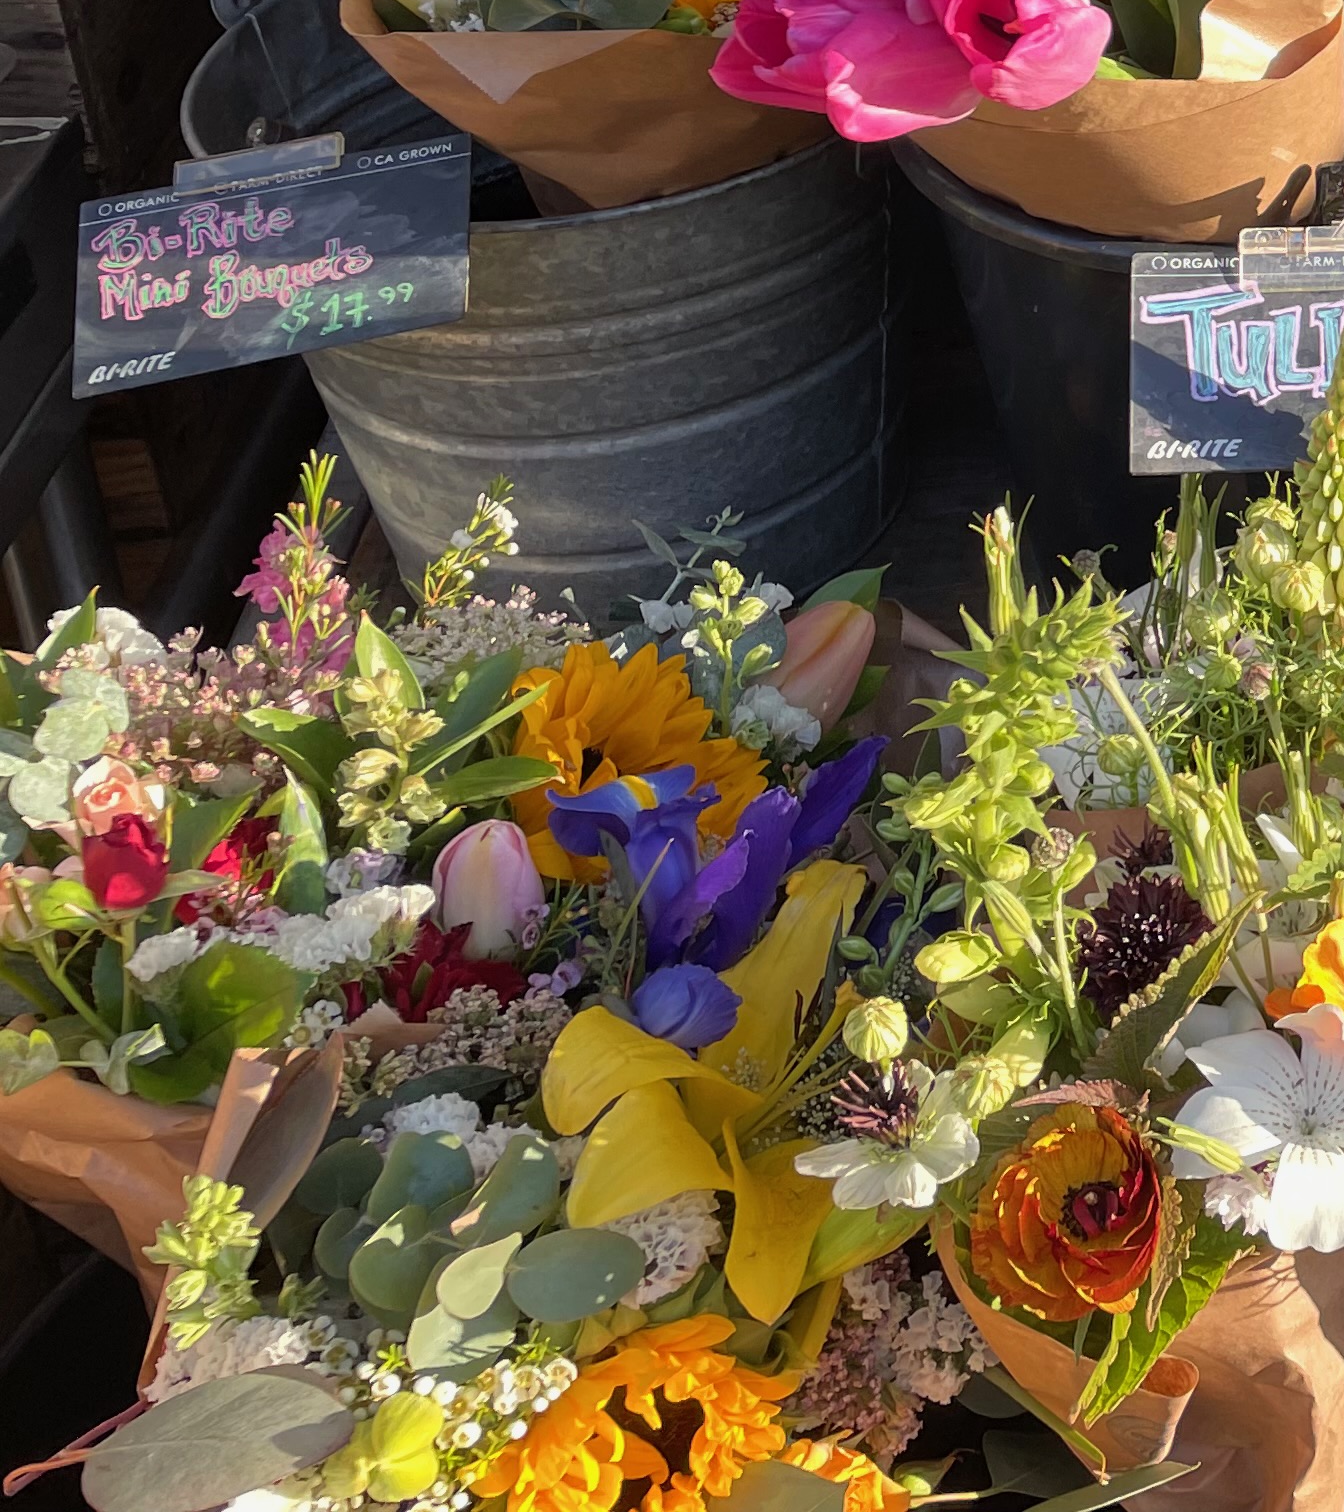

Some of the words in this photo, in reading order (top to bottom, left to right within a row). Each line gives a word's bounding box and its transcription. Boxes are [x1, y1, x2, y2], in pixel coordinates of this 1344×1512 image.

[373, 153, 395, 166] CA
[398, 141, 453, 161] GROWN
[113, 192, 181, 213] ORGANIC
[90, 197, 295, 274] Bi-Rite
[98, 268, 192, 321] Mini
[201, 236, 375, 320] Bouquets
[1169, 255, 1240, 271] ORGANIC
[280, 281, 415, 350] $17.99
